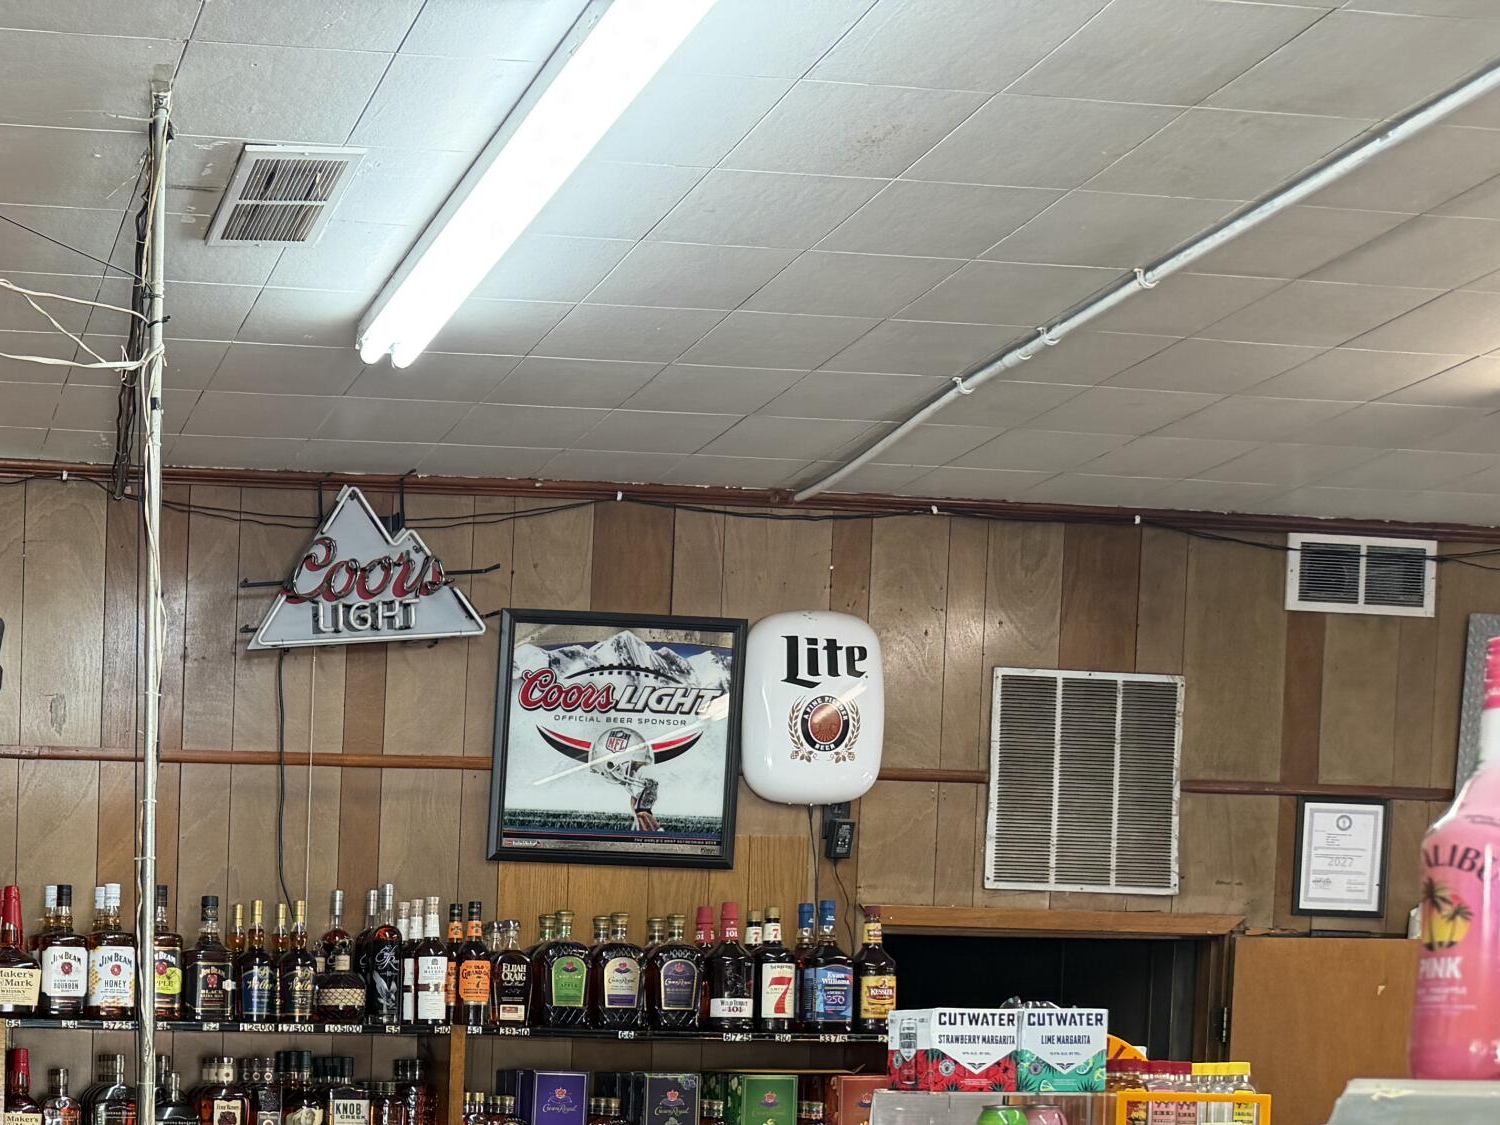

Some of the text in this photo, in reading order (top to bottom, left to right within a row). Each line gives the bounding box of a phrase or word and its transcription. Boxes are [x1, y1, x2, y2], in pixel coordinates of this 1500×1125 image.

[281, 537, 453, 604] Coors
[312, 598, 420, 634] LIGHT
[780, 635, 868, 689] Lite
[518, 666, 723, 716] Coors LIGHT
[554, 714, 601, 723] OFFICIAL
[637, 718, 687, 726] SPONSOR
[608, 737, 626, 751] NFL
[725, 930, 738, 938] 101
[51, 951, 82, 966] JIM BEAM
[99, 952, 133, 968] JIM BEAM
[502, 962, 527, 973] ELIJAH
[501, 971, 526, 982] CRAIG
[827, 971, 845, 980] Evan
[4, 977, 33, 988] Mark
[104, 979, 127, 988] HONEY
[821, 977, 850, 986] Williams
[768, 976, 793, 1014] 7
[938, 1011, 1016, 1027] CUTWATER
[1027, 1011, 1104, 1027] CUTWATER
[386, 1025, 401, 1034] 55
[618, 1030, 634, 1039] 66
[723, 1032, 751, 1042] 6725
[775, 1033, 791, 1042] 30
[820, 1033, 847, 1043] 3375
[938, 1034, 1016, 1045] STRAWBERRY MARGARITA
[1041, 1034, 1091, 1045] LIME MARGARITA
[334, 1102, 362, 1116] KNOB
[6, 1115, 39, 1123] Maker's
[339, 1113, 366, 1121] CREEK
